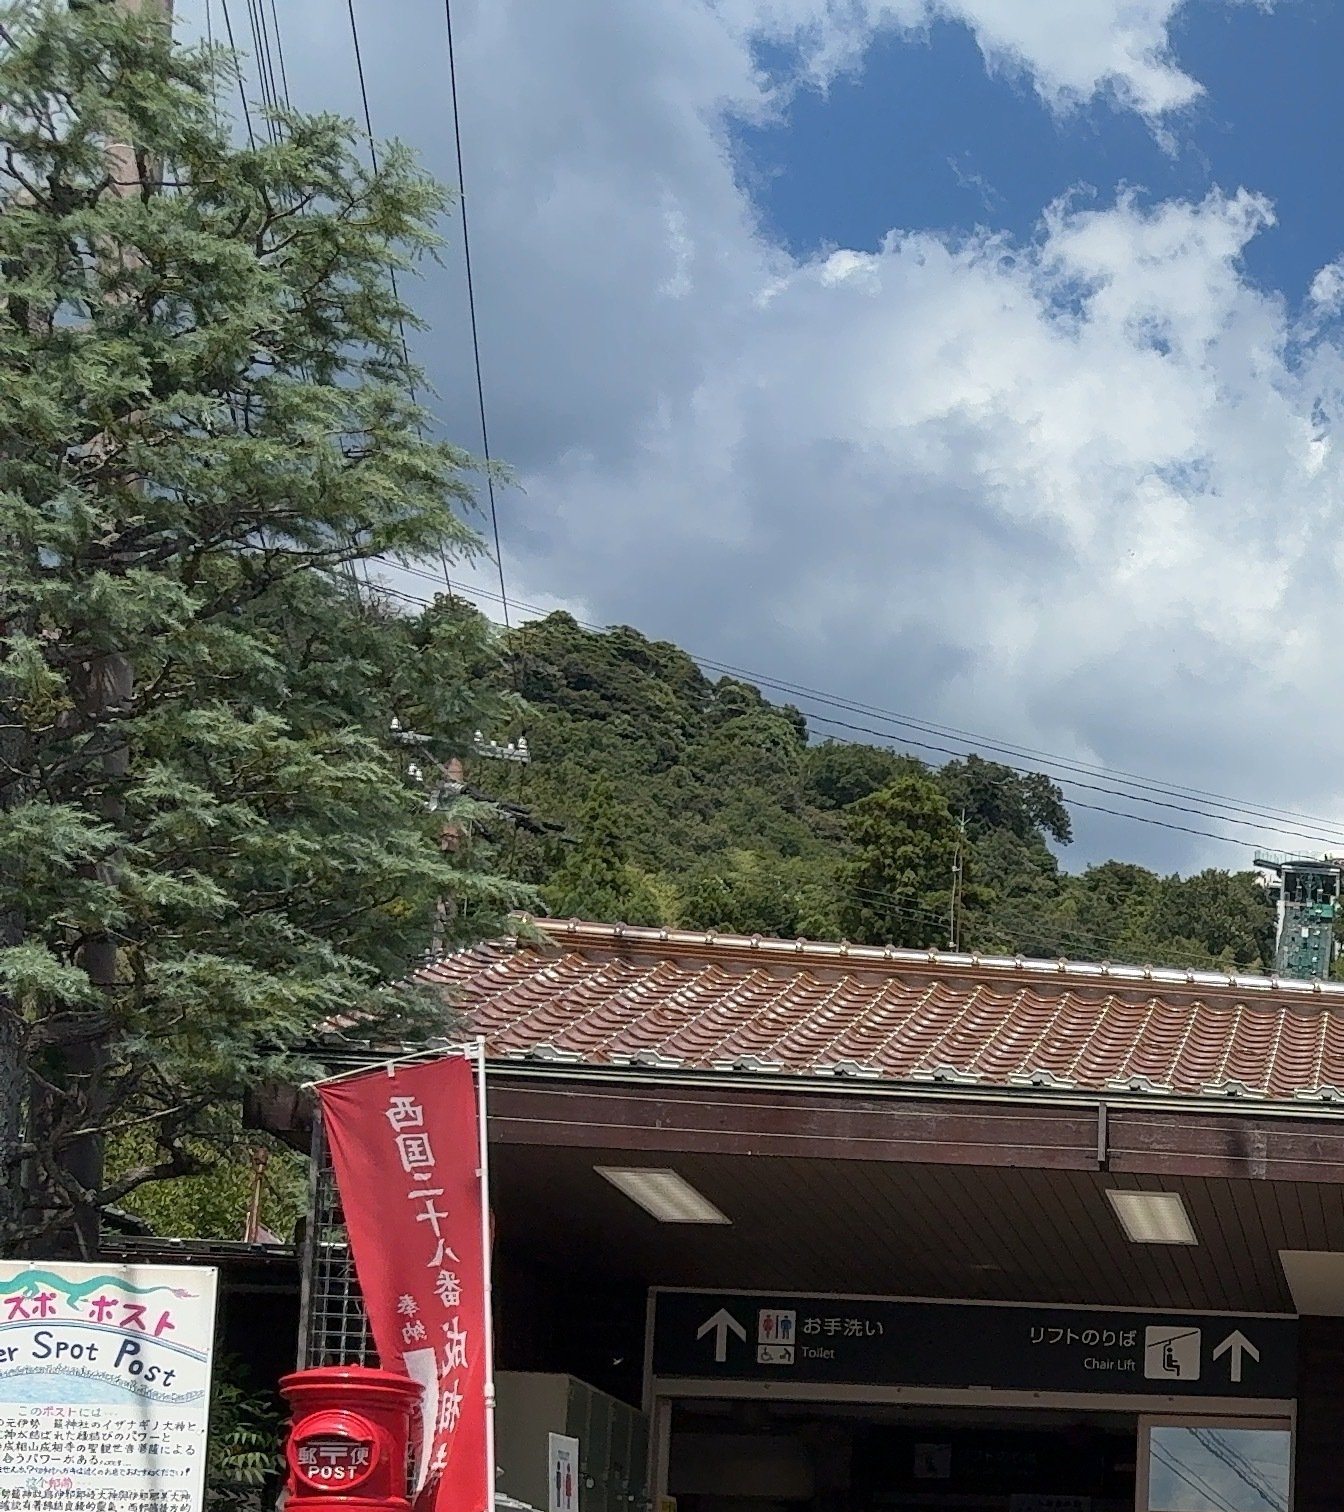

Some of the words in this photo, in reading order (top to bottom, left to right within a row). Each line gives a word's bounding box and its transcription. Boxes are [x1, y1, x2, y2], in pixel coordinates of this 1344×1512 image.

[89, 1295, 175, 1337] ポスト
[803, 1317, 884, 1338] お手洗い
[1030, 1326, 1137, 1348] リフトのりば
[32, 1331, 98, 1360] Spot
[114, 1338, 176, 1387] Post
[802, 1346, 836, 1360] Toilet
[1084, 1357, 1114, 1371] Chair
[1117, 1359, 1137, 1372] Lift
[308, 1466, 357, 1480] POST
